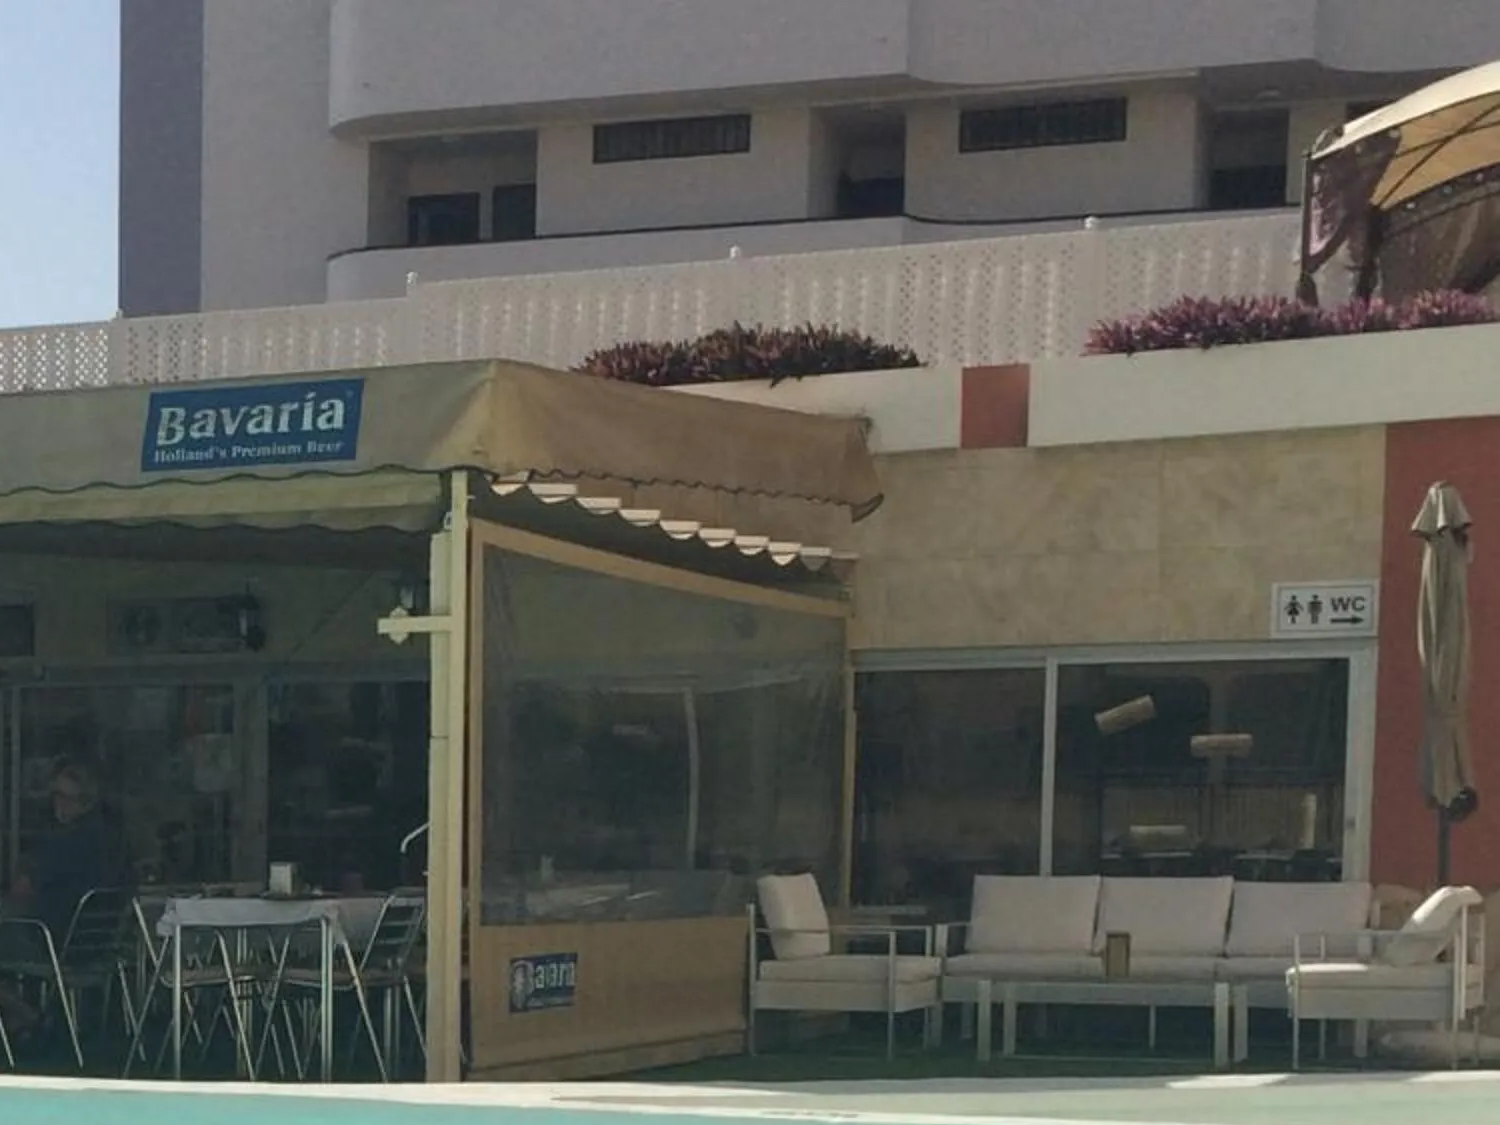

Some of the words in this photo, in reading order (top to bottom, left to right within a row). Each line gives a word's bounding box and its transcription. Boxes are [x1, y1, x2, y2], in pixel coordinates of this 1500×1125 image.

[154, 445, 229, 464] Holland's
[231, 440, 303, 459] Premium
[307, 439, 344, 453] Beer
[1330, 596, 1366, 612] WC
